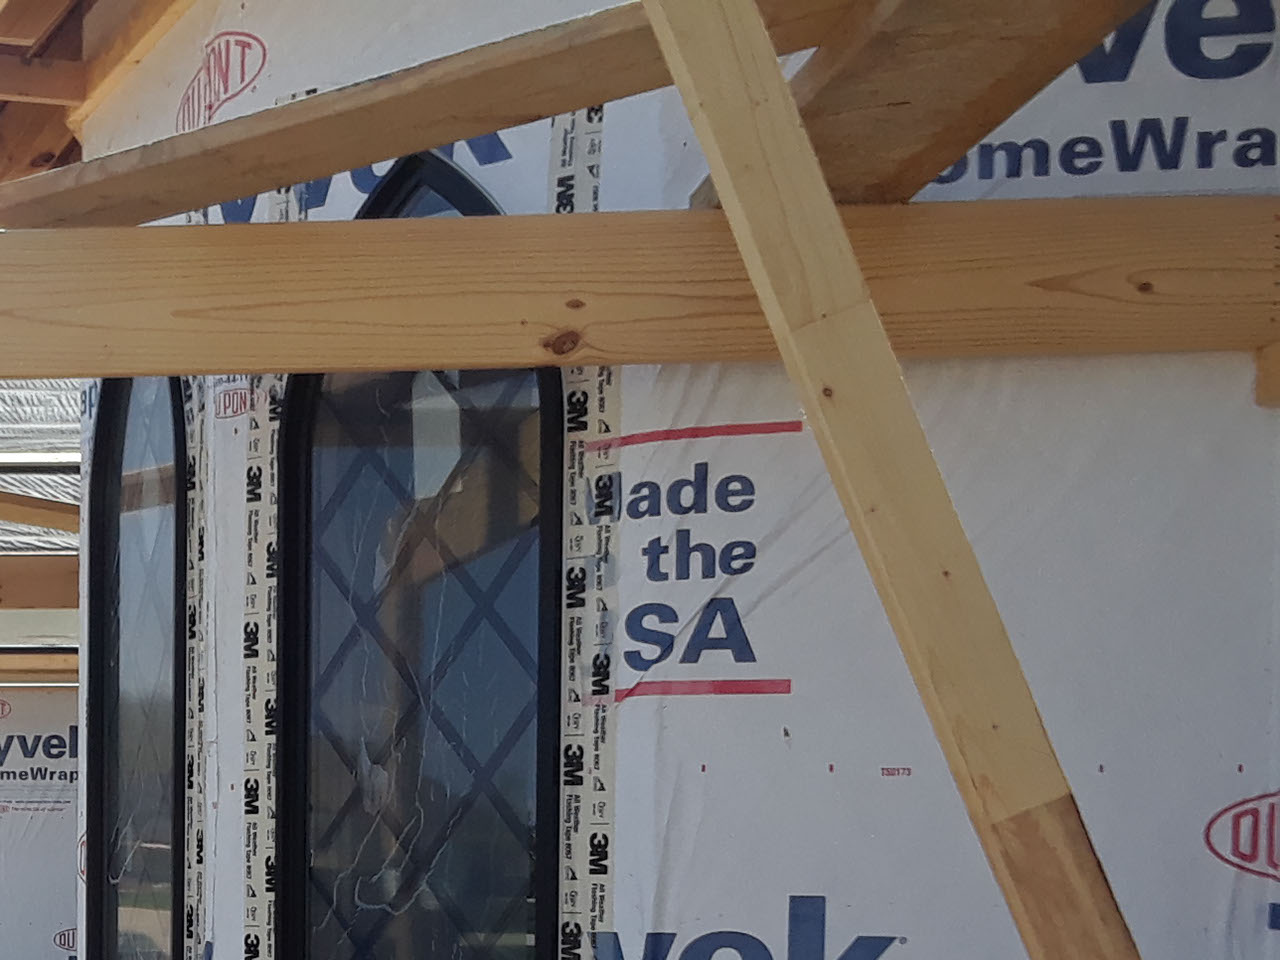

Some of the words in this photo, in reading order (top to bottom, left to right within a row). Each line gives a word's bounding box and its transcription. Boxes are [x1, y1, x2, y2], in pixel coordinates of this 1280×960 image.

[556, 175, 574, 214] 3M
[568, 390, 588, 433] 3M
[247, 466, 262, 503] 3M
[642, 529, 756, 582] the
[566, 566, 586, 609] 3M
[244, 622, 259, 659] 3M
[592, 654, 611, 696] 3M
[564, 744, 584, 786] 3M
[244, 778, 259, 815] 3M
[565, 826, 574, 841] Tape
[589, 833, 609, 875] 3M
